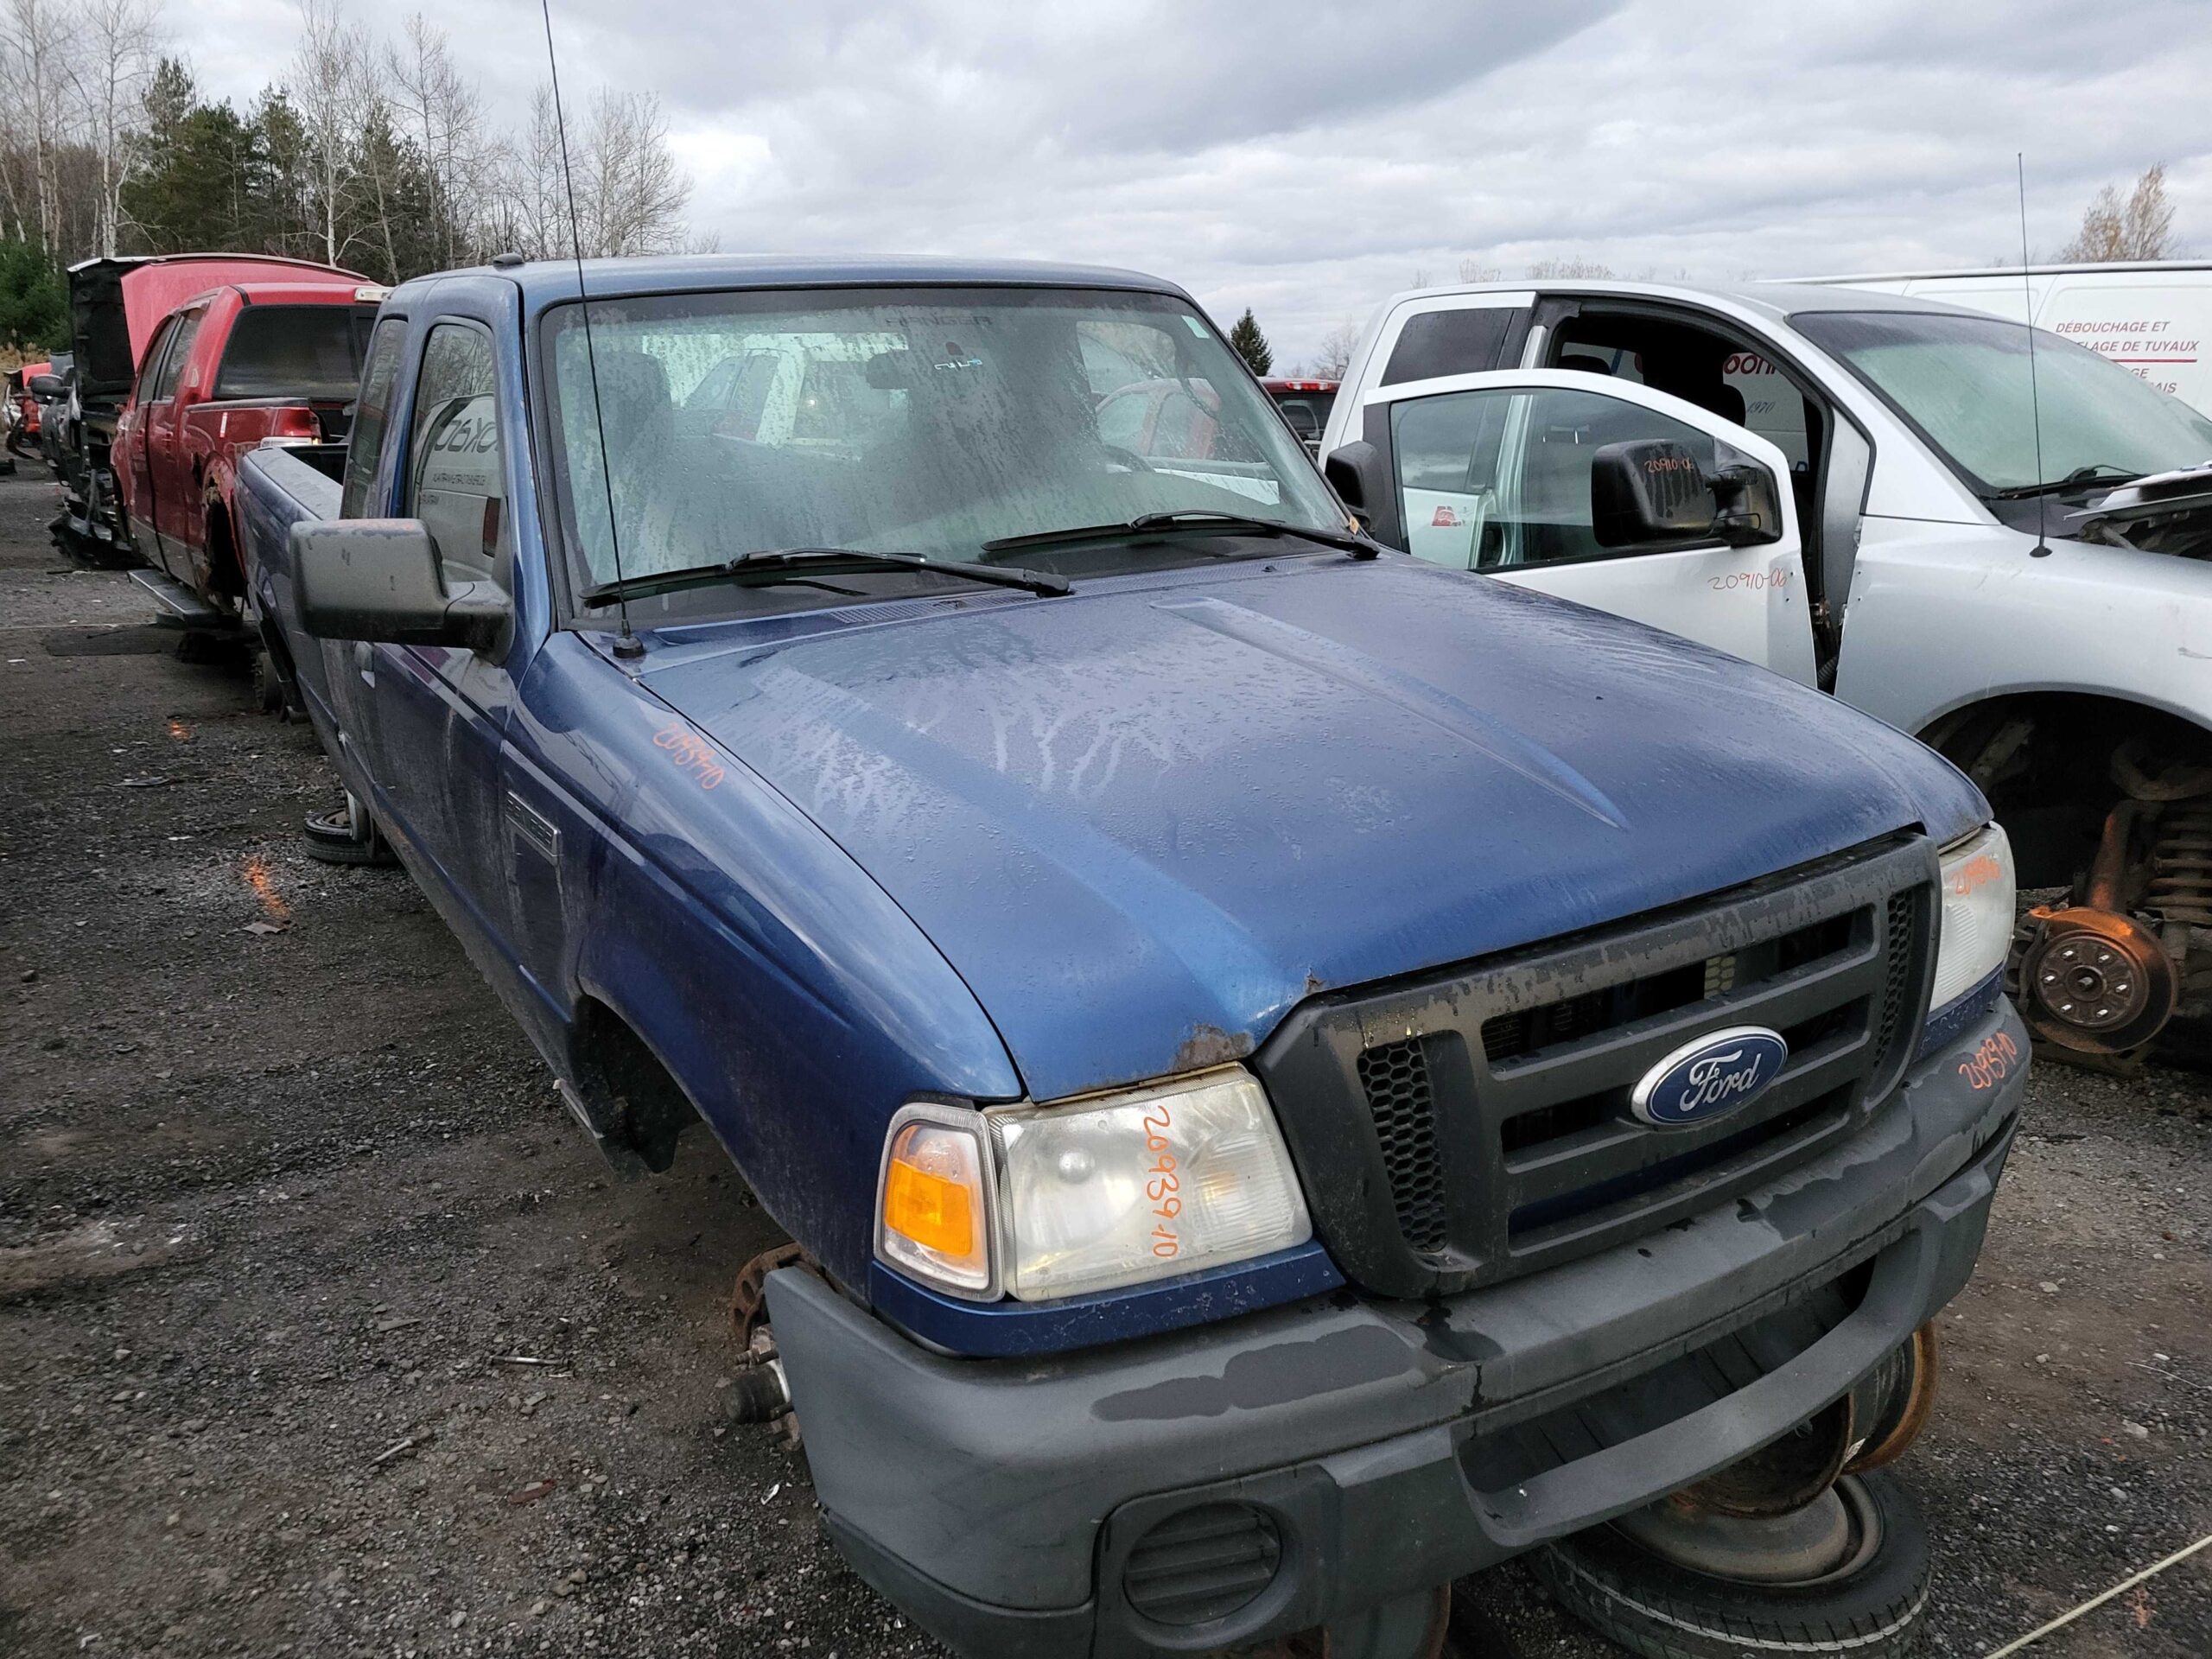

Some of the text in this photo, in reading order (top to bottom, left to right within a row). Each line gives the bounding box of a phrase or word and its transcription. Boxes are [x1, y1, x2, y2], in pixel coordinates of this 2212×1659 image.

[2056, 320, 2171, 334] DÉBOUCHAGE ET
[2121, 341, 2140, 352] DE
[2145, 340, 2200, 352] TUYAUX
[1746, 401, 1777, 414] 1970
[1707, 568, 1787, 590] 20910-06
[1679, 1049, 1762, 1112] Ford
